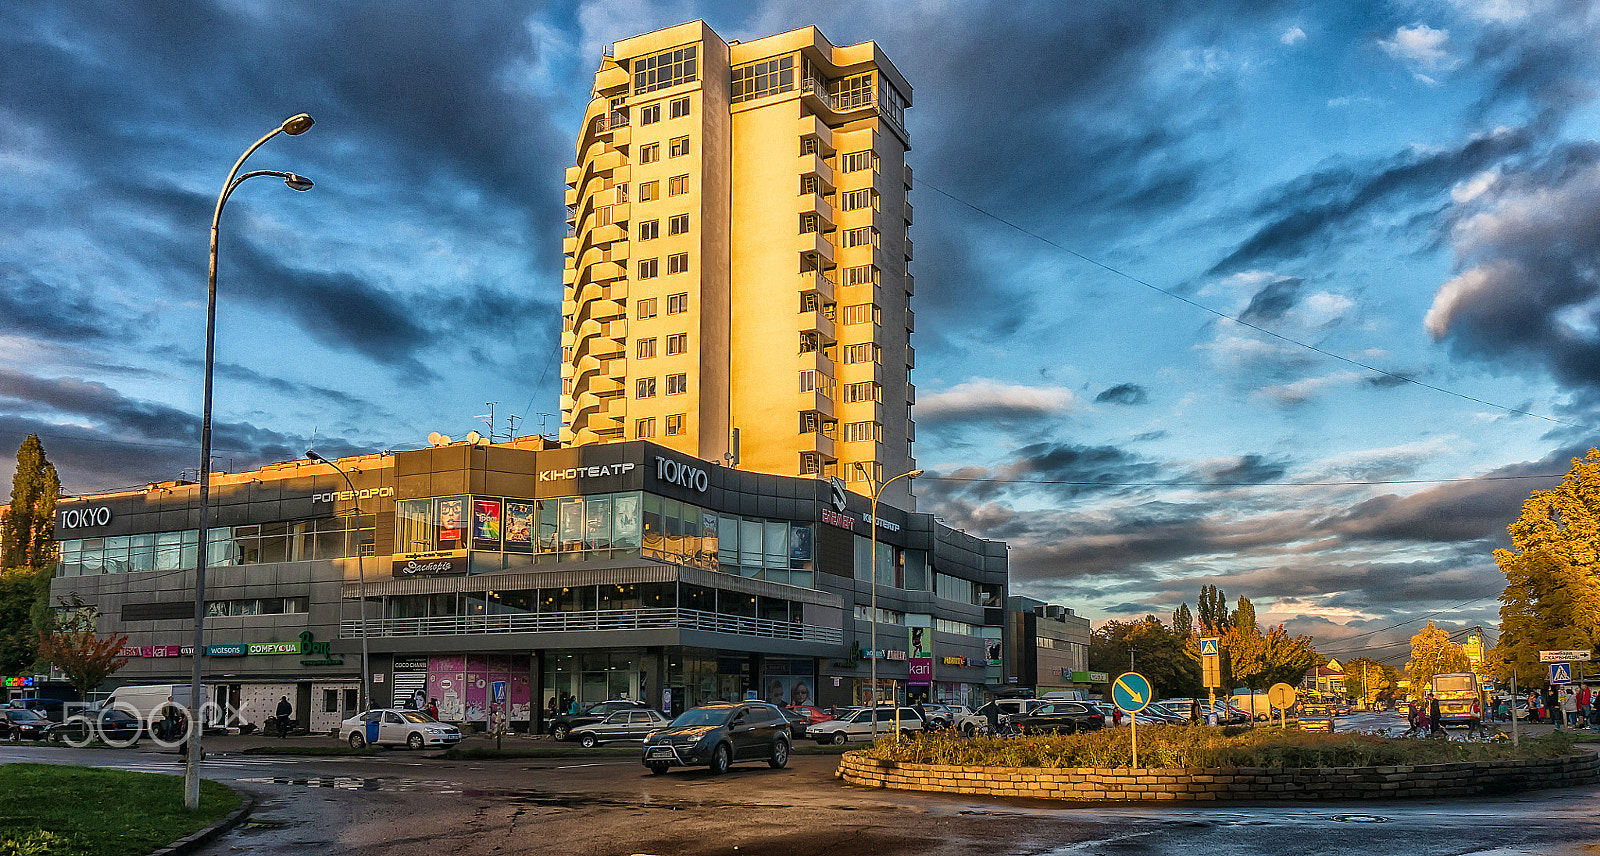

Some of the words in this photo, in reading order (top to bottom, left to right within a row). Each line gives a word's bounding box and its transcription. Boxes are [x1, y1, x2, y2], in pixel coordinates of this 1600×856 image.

[539, 462, 635, 482] КІНОТЕАТР
[654, 455, 708, 493] TOKYO
[61, 506, 110, 529] TOKYO
[152, 645, 167, 657] kari
[211, 646, 241, 655] watsons
[909, 662, 930, 675] kari
